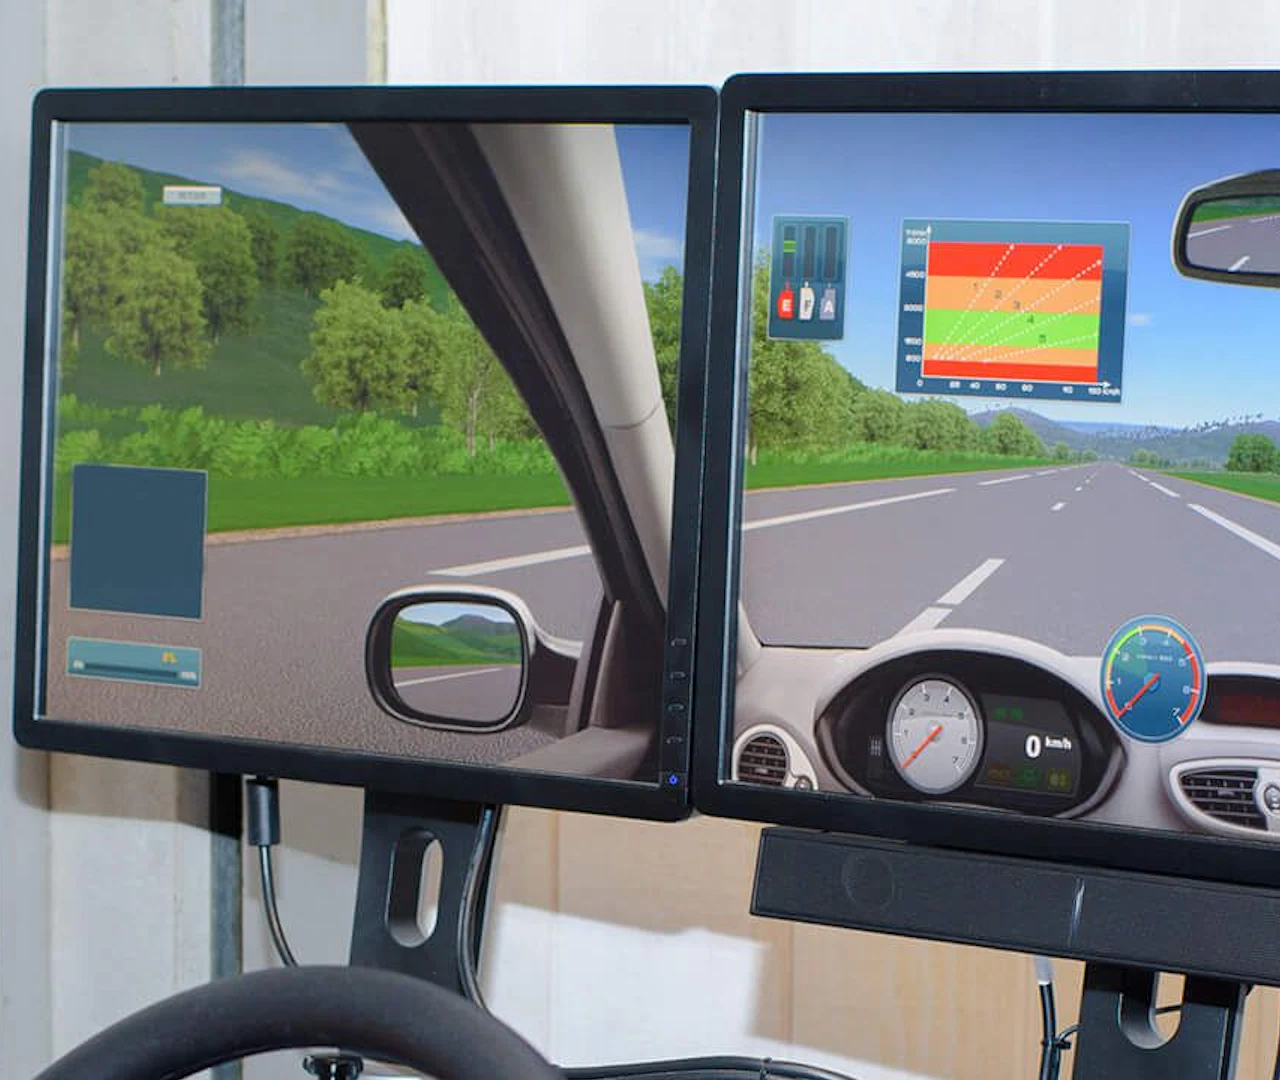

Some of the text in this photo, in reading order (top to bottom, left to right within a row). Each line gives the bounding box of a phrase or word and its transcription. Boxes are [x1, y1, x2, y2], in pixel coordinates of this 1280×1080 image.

[782, 299, 792, 312] E
[823, 299, 834, 312] A
[1025, 734, 1041, 758] 0
